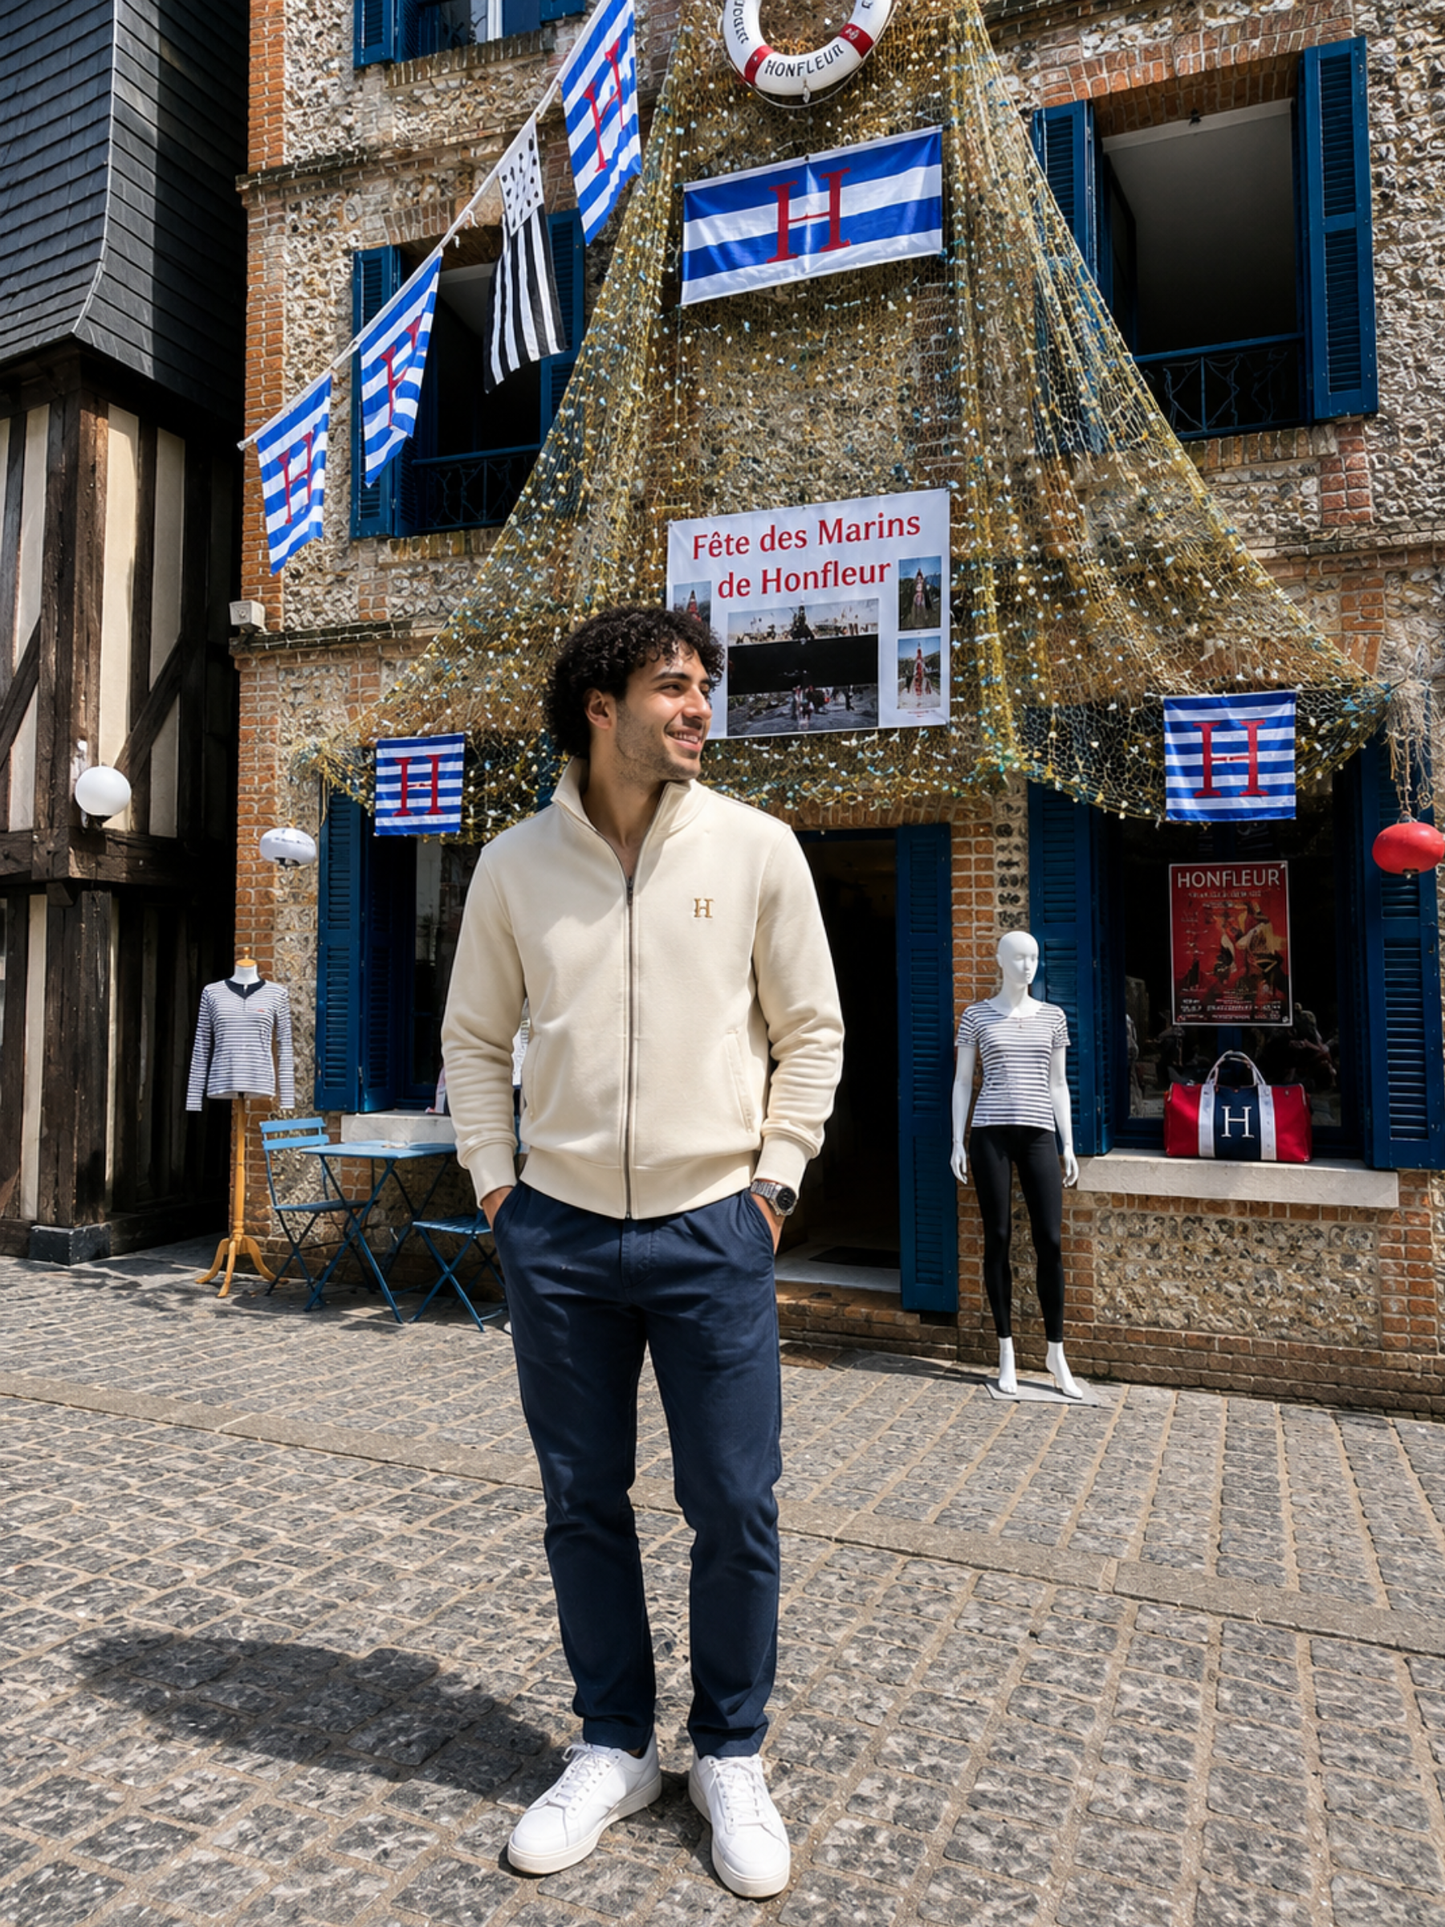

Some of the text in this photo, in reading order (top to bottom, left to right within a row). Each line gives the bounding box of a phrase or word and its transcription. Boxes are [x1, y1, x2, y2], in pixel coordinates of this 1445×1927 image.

[764, 44, 844, 77] HONFLEUR
[766, 168, 850, 263] H
[692, 512, 921, 560] Fête des Marins
[718, 560, 891, 599] de Honfleur
[1193, 720, 1269, 797] H
[392, 753, 445, 817] H
[1177, 869, 1280, 888] HONFLEUR
[694, 898, 714, 918] H
[1221, 1105, 1254, 1138] H
